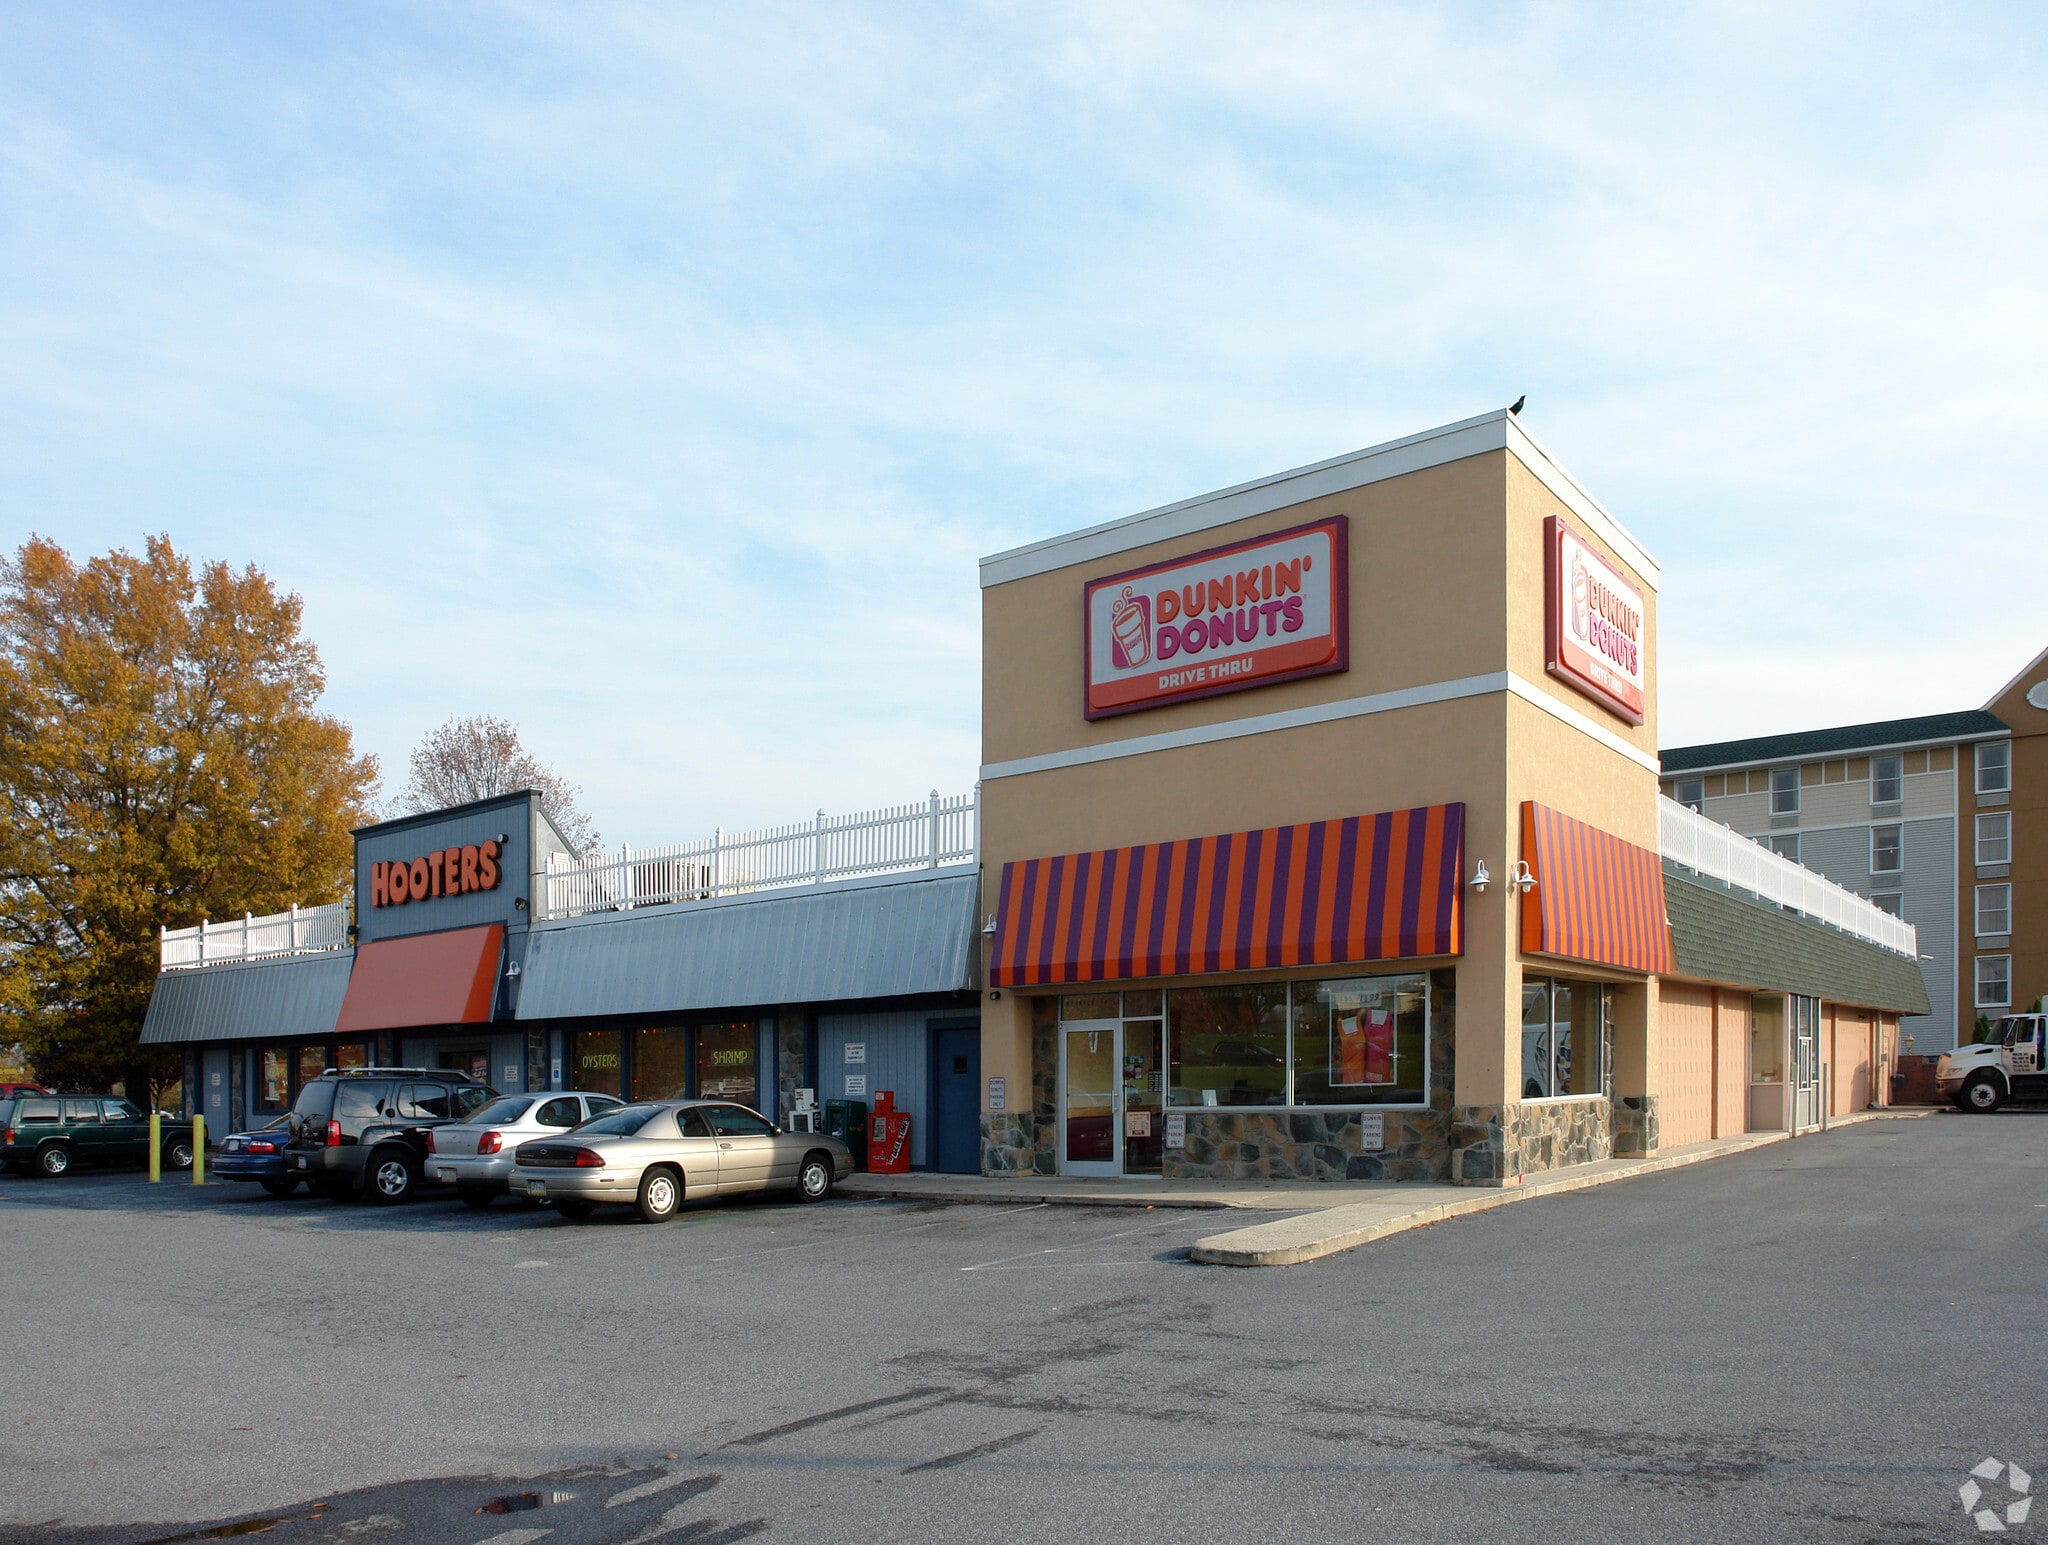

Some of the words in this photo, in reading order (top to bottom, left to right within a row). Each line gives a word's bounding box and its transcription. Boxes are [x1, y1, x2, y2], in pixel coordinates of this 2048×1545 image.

[1156, 555, 1312, 624] DUNKIN'
[1590, 575, 1639, 642] DUNKIN'
[1156, 595, 1305, 660] DONUTS
[1590, 611, 1638, 676] DONUTS
[1158, 667, 1206, 690] DRIVE
[1208, 657, 1254, 679] THRU
[1590, 661, 1607, 684] DRIVE
[371, 839, 502, 908] HOOTERS
[582, 1054, 618, 1068] OYSTERS
[713, 1050, 748, 1065] SHRIMP
